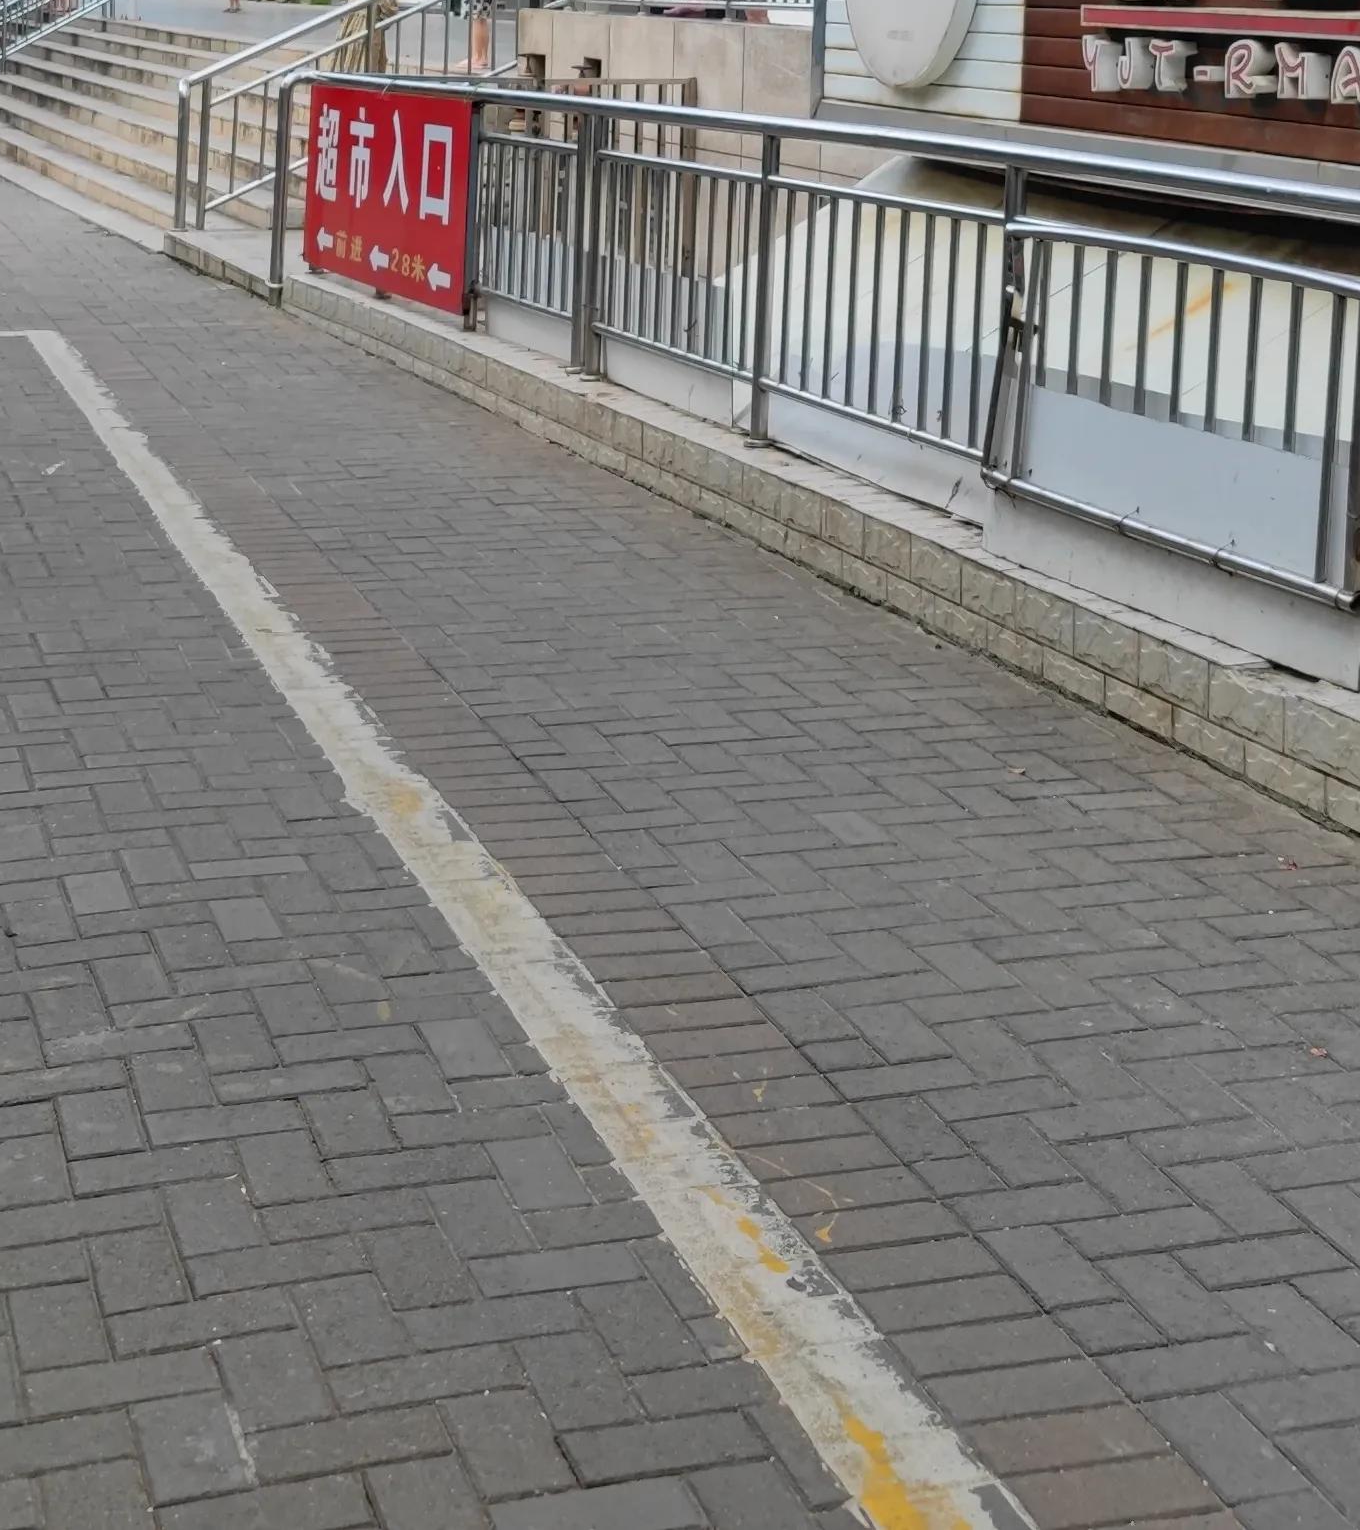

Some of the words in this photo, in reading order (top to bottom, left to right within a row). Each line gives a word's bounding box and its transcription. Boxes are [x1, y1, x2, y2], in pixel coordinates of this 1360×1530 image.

[315, 103, 453, 226] 超市入口
[334, 230, 364, 263] 前进
[391, 247, 426, 283] 28米
